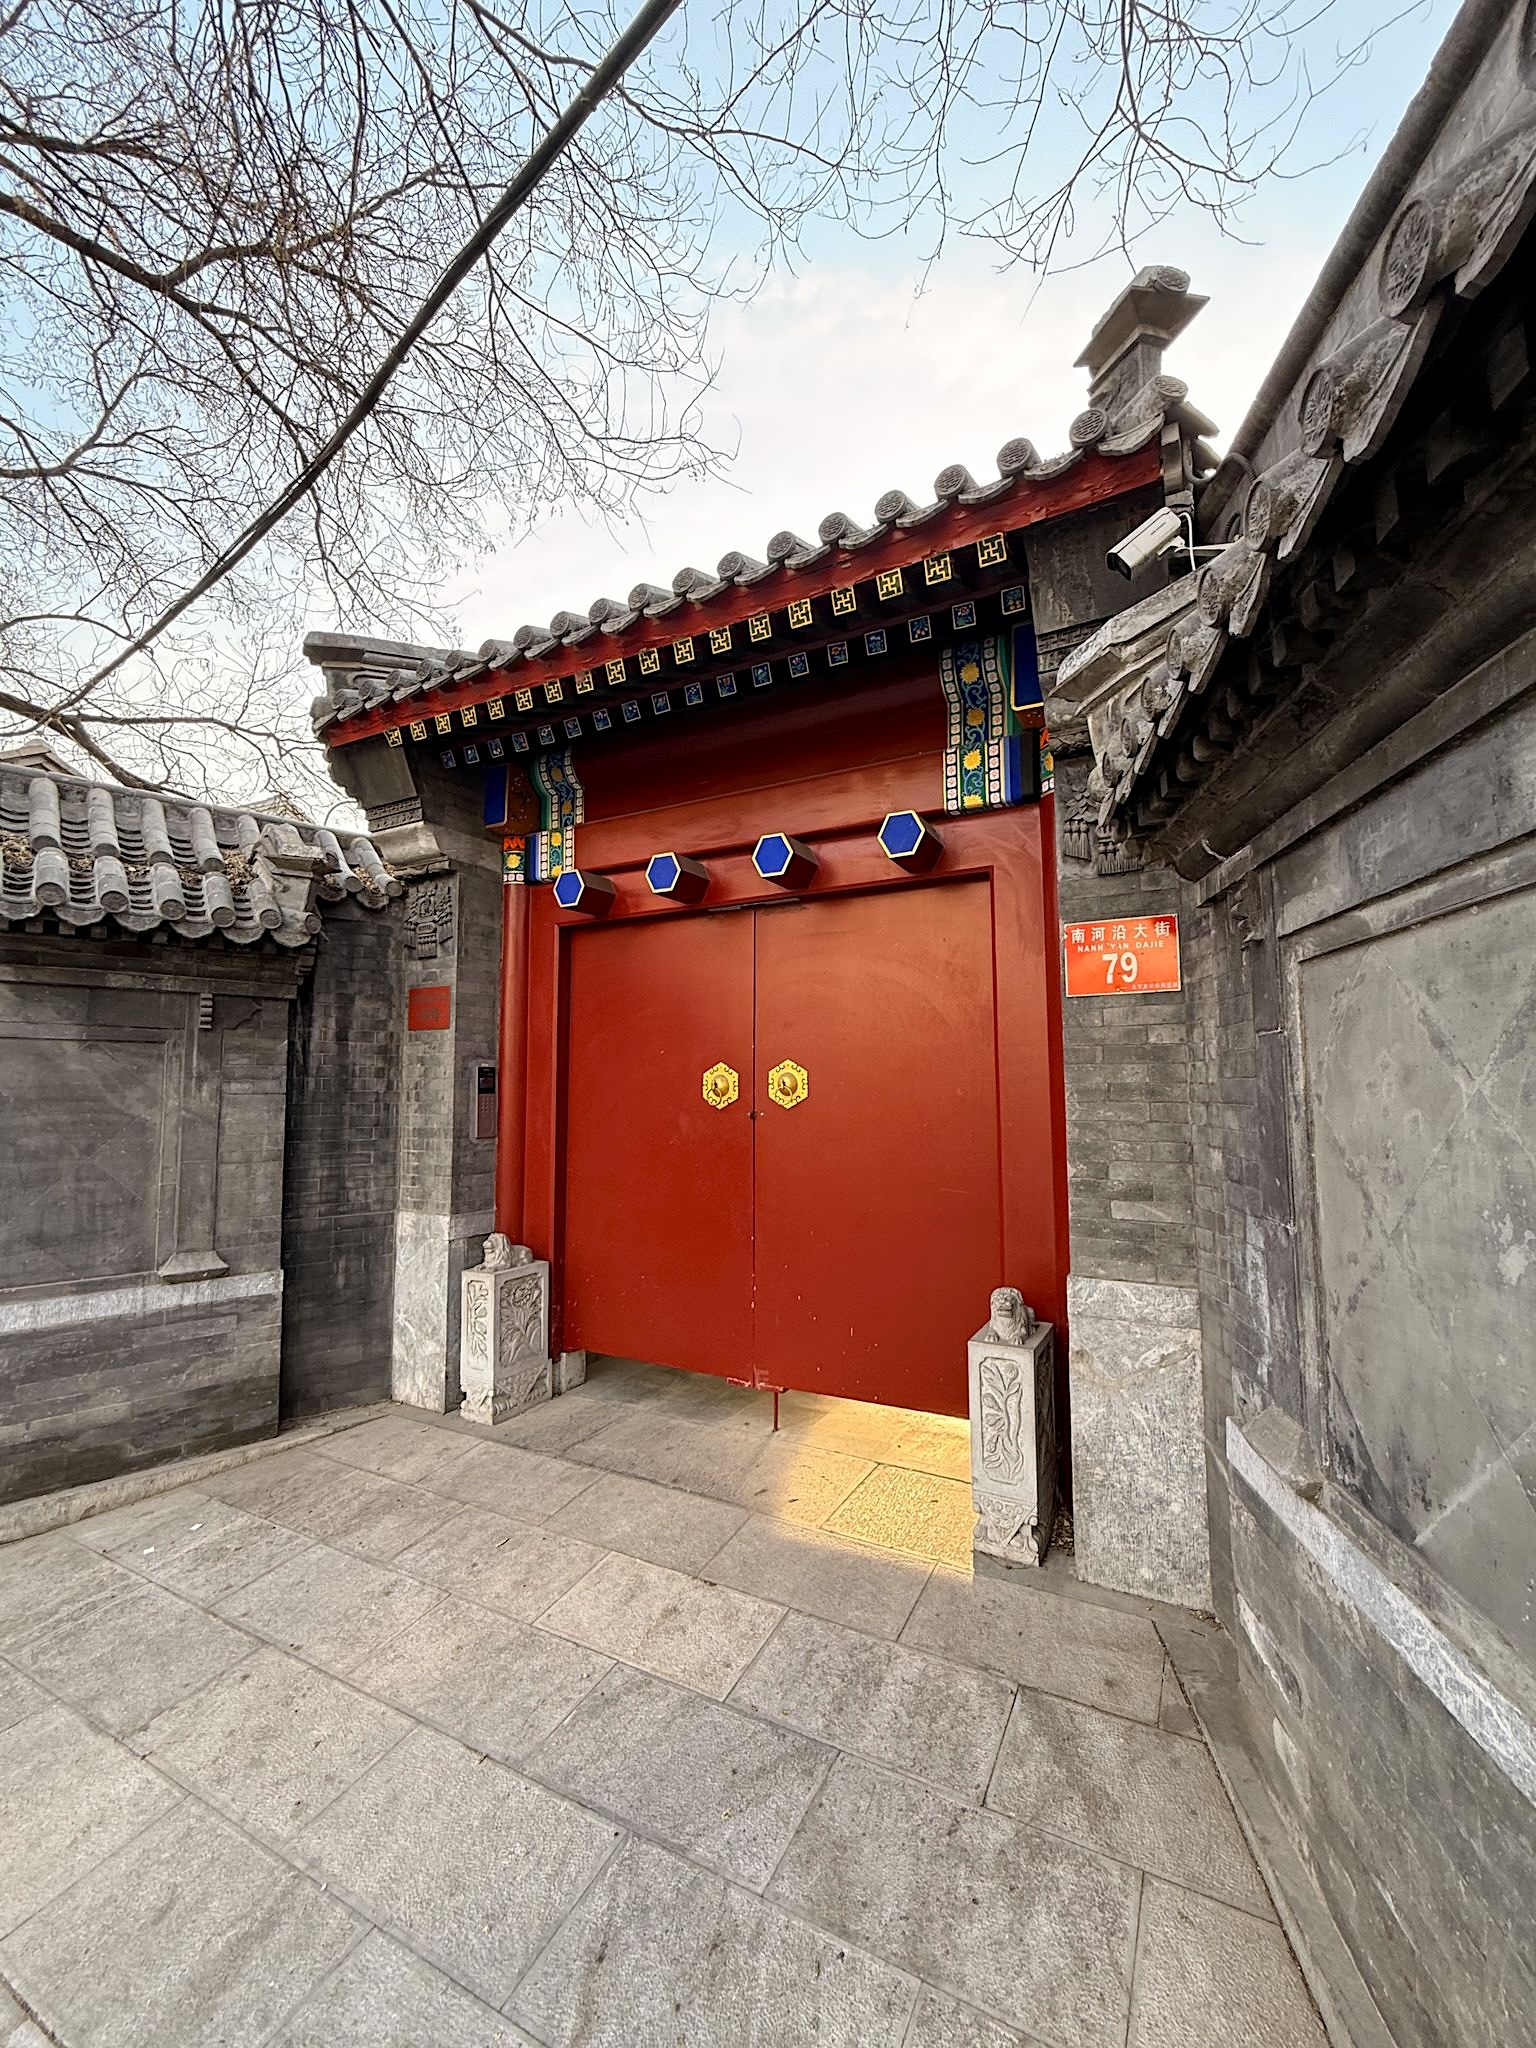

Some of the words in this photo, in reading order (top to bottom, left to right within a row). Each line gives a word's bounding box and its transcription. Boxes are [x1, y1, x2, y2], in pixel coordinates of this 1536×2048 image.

[1071, 921, 1170, 943] 南河沿大街
[1135, 940, 1165, 949] DAJIE
[1102, 951, 1139, 984] 79
